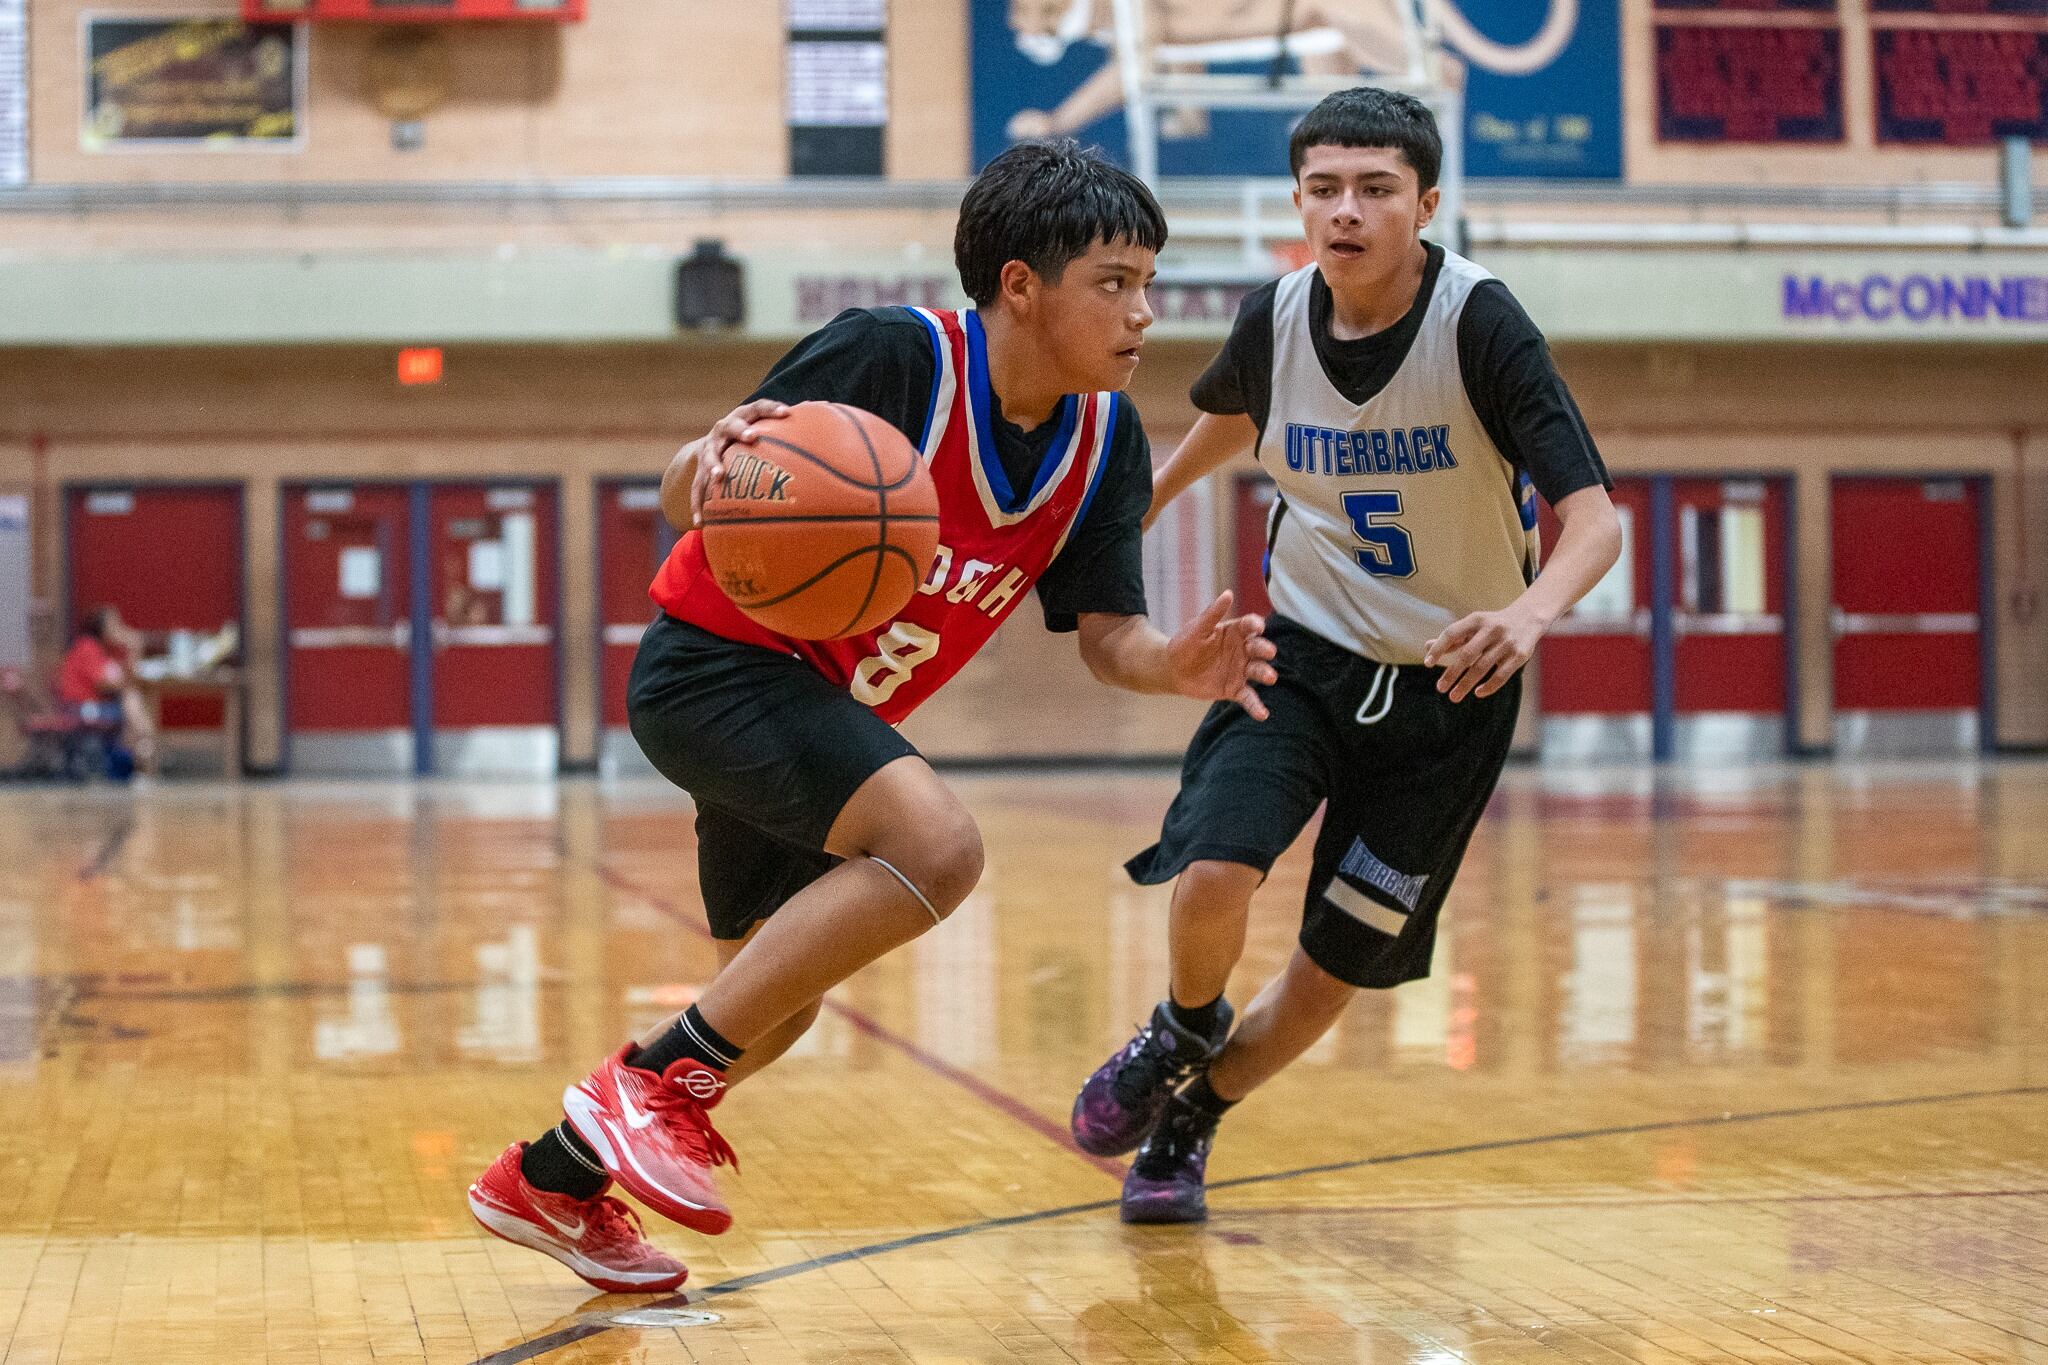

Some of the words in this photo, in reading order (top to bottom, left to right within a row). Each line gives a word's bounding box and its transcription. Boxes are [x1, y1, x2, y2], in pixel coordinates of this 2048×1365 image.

[720, 453, 792, 502] ROCK
[1285, 423, 1459, 476] UTTERBACK
[1339, 490, 1418, 579] 5
[851, 621, 940, 706] 8
[1339, 834, 1431, 912] UTTERBACK
